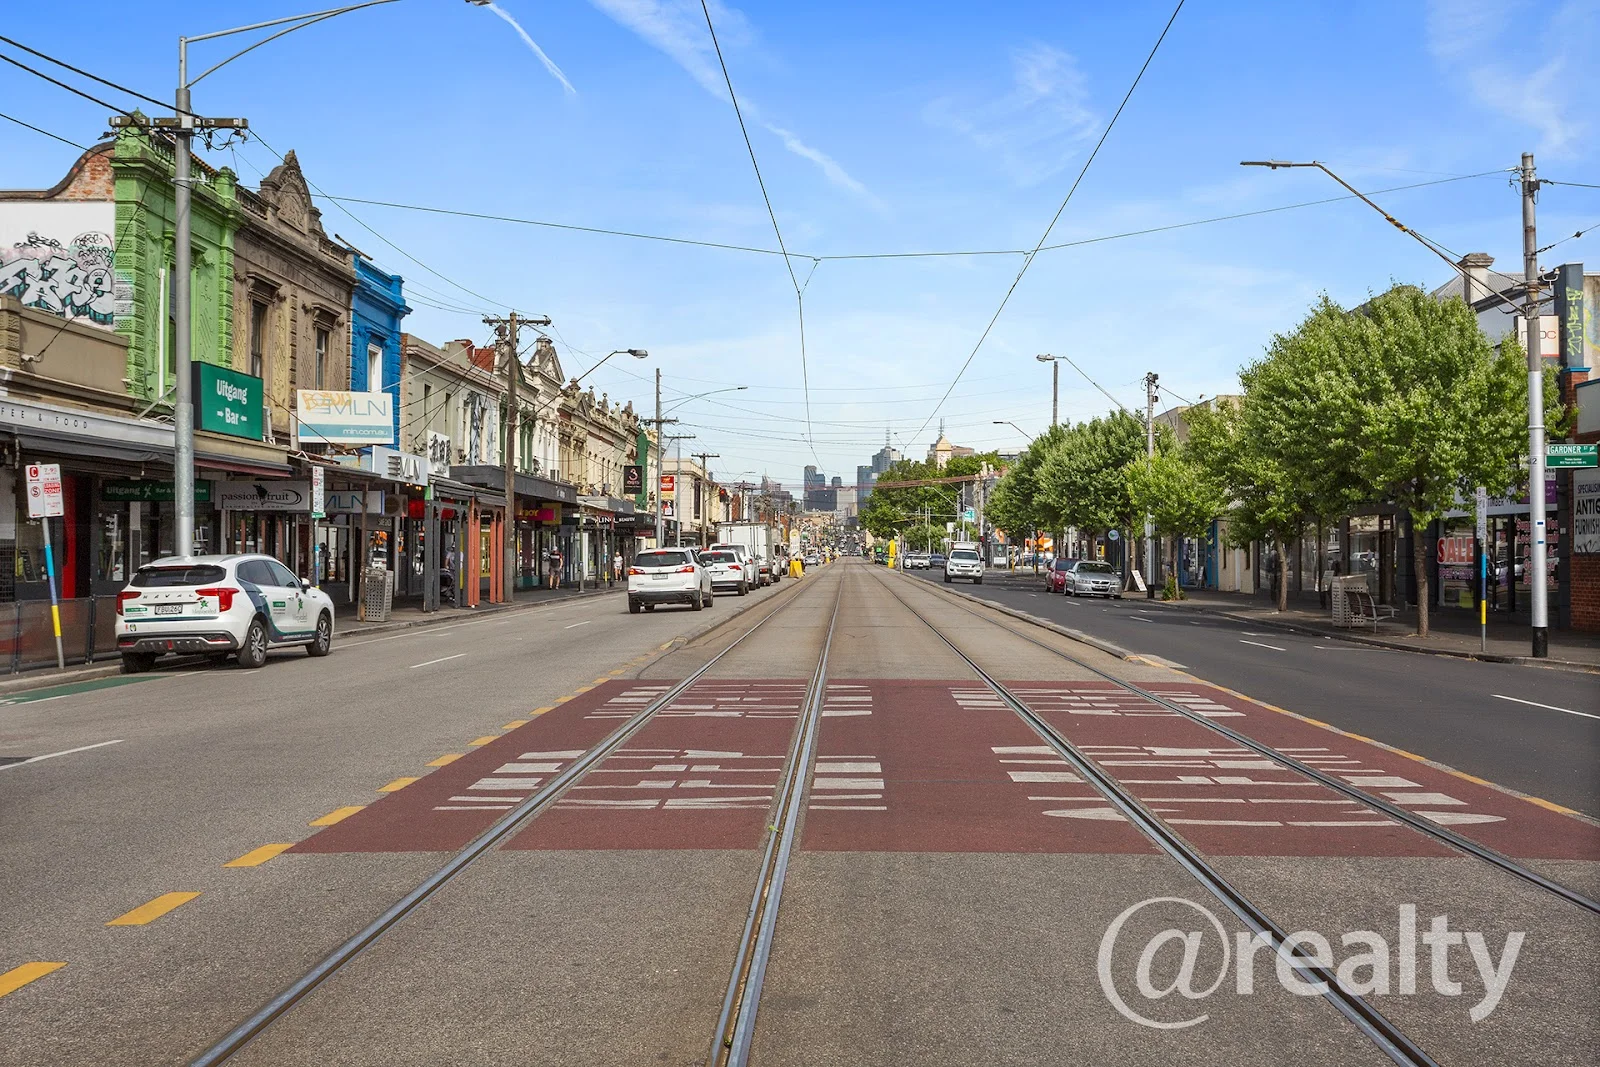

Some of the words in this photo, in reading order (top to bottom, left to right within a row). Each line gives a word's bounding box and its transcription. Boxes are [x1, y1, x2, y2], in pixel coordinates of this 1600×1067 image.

[216, 379, 248, 405] Uitgang
[56, 416, 88, 429] FOOD
[225, 407, 239, 425] Bar
[343, 428, 388, 436] mln.com.au
[1550, 445, 1582, 454] GARDNER
[106, 486, 140, 496] Uitgang
[221, 492, 259, 509] passion
[267, 492, 290, 501] fruit
[1437, 537, 1474, 565] SALE
